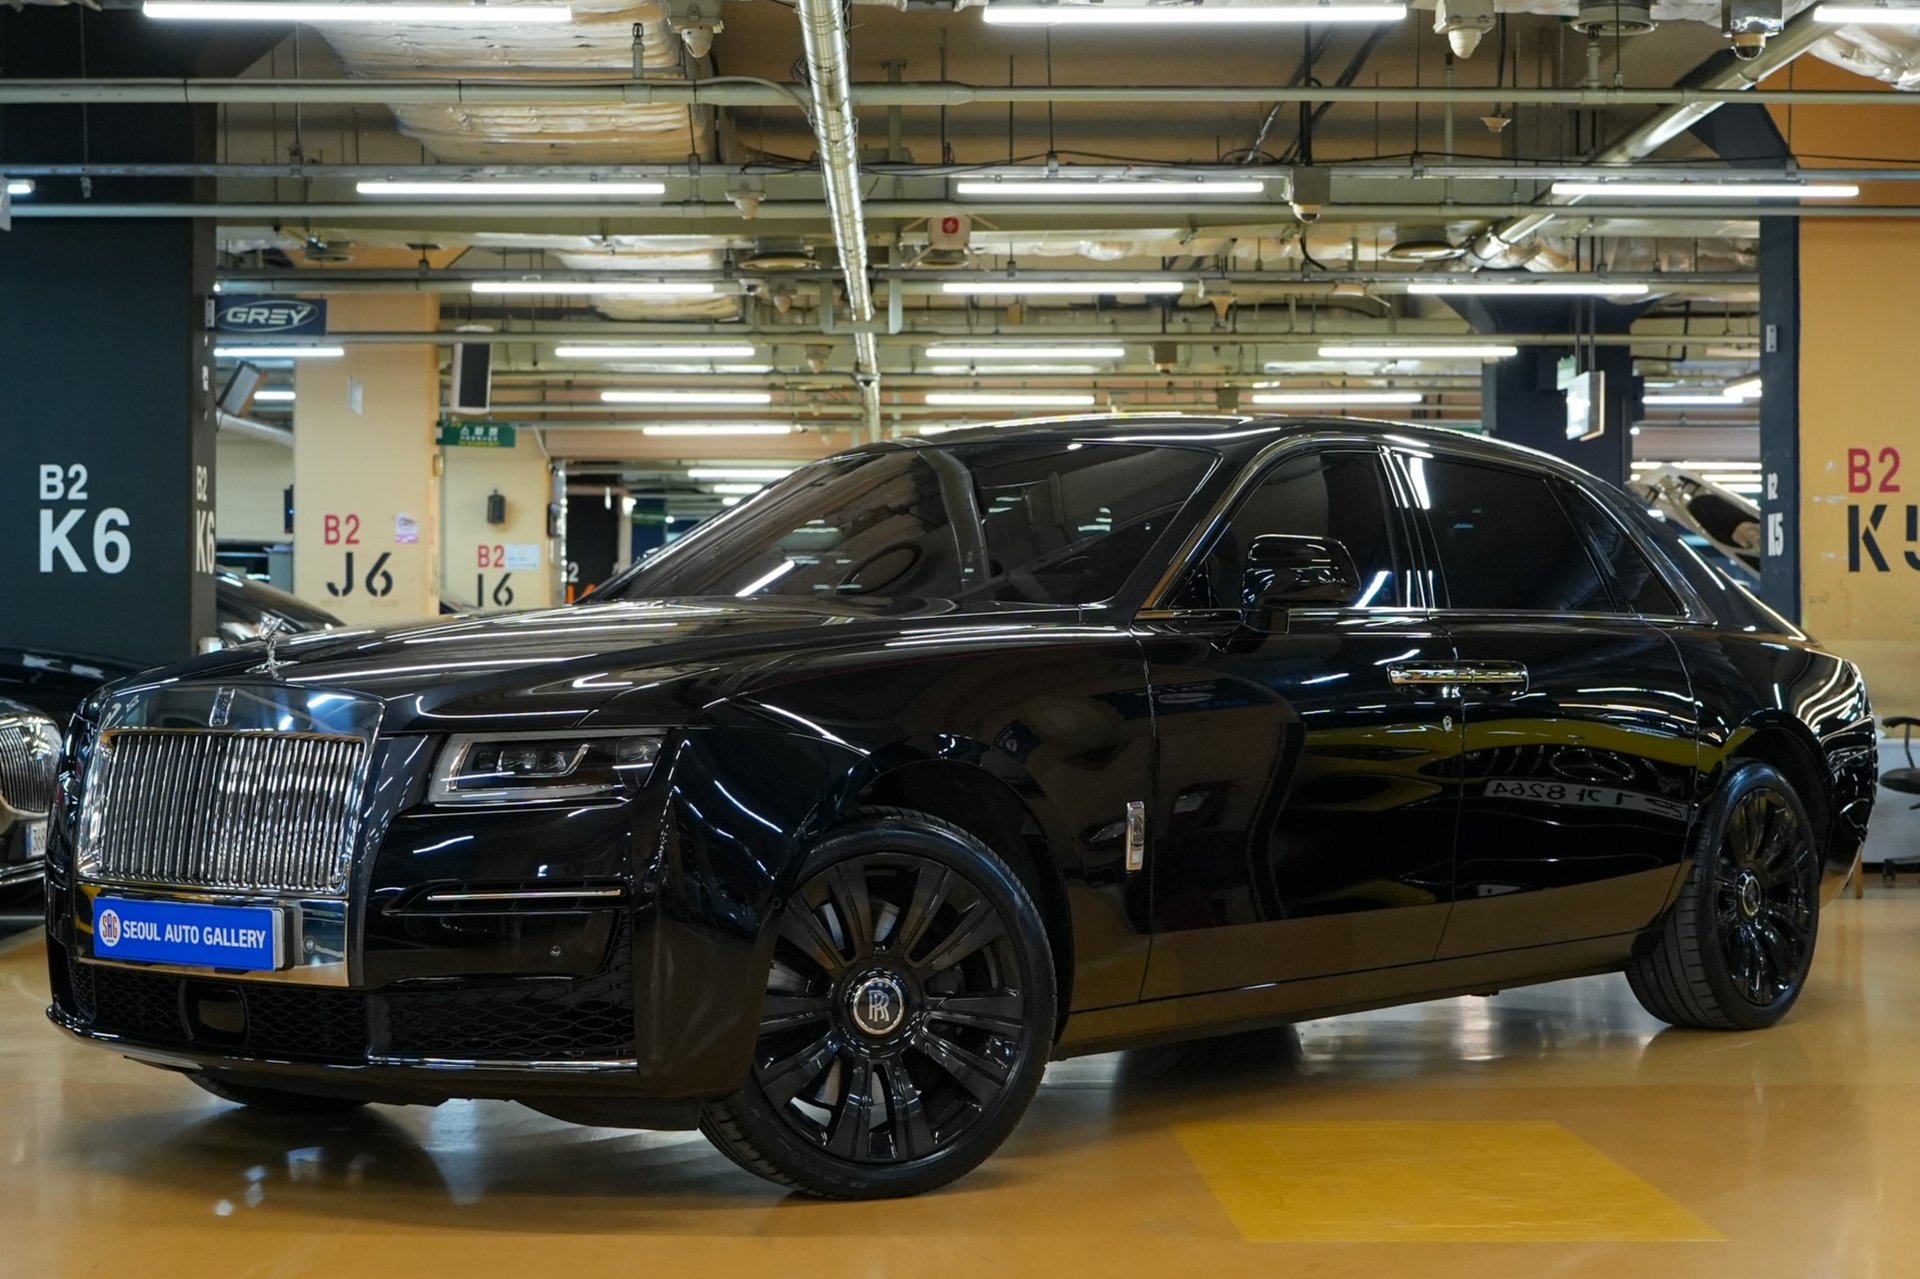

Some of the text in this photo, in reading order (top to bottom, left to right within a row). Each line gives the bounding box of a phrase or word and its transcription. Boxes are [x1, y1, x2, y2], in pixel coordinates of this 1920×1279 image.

[226, 305, 311, 325] GREY
[40, 463, 88, 500] B2
[196, 465, 208, 502] B2
[1848, 447, 1900, 493] B2
[40, 507, 131, 574] K6
[196, 509, 215, 575] K6
[324, 513, 360, 545] B2
[1767, 512, 1784, 557] K5
[326, 551, 393, 597] J6
[477, 544, 505, 568] B2
[123, 919, 161, 942] SEOUL
[164, 923, 200, 945] AUTO
[203, 926, 267, 949] GALLERY
